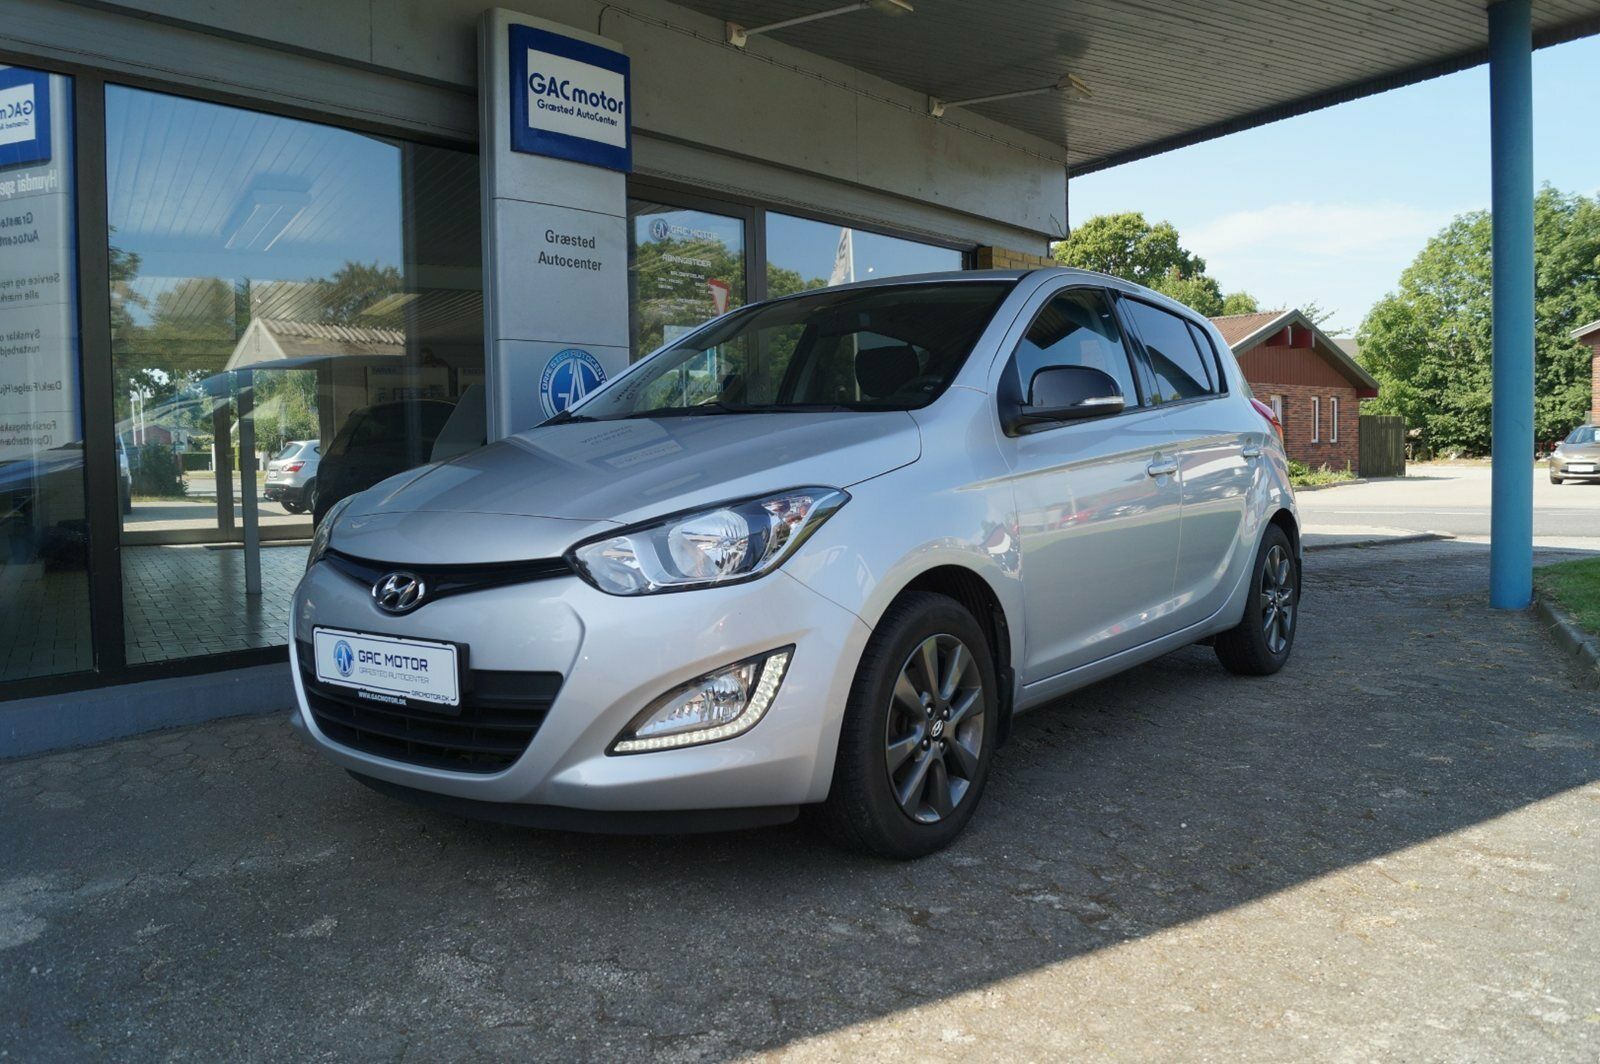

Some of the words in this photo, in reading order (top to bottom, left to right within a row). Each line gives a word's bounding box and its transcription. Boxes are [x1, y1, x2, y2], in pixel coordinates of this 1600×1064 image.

[537, 98, 574, 116] Græsted
[576, 107, 618, 127] AutoCenter
[545, 229, 596, 249] Græsted
[538, 250, 603, 271] Autocenter
[358, 649, 382, 666] GAC
[384, 653, 429, 673] MOTOR
